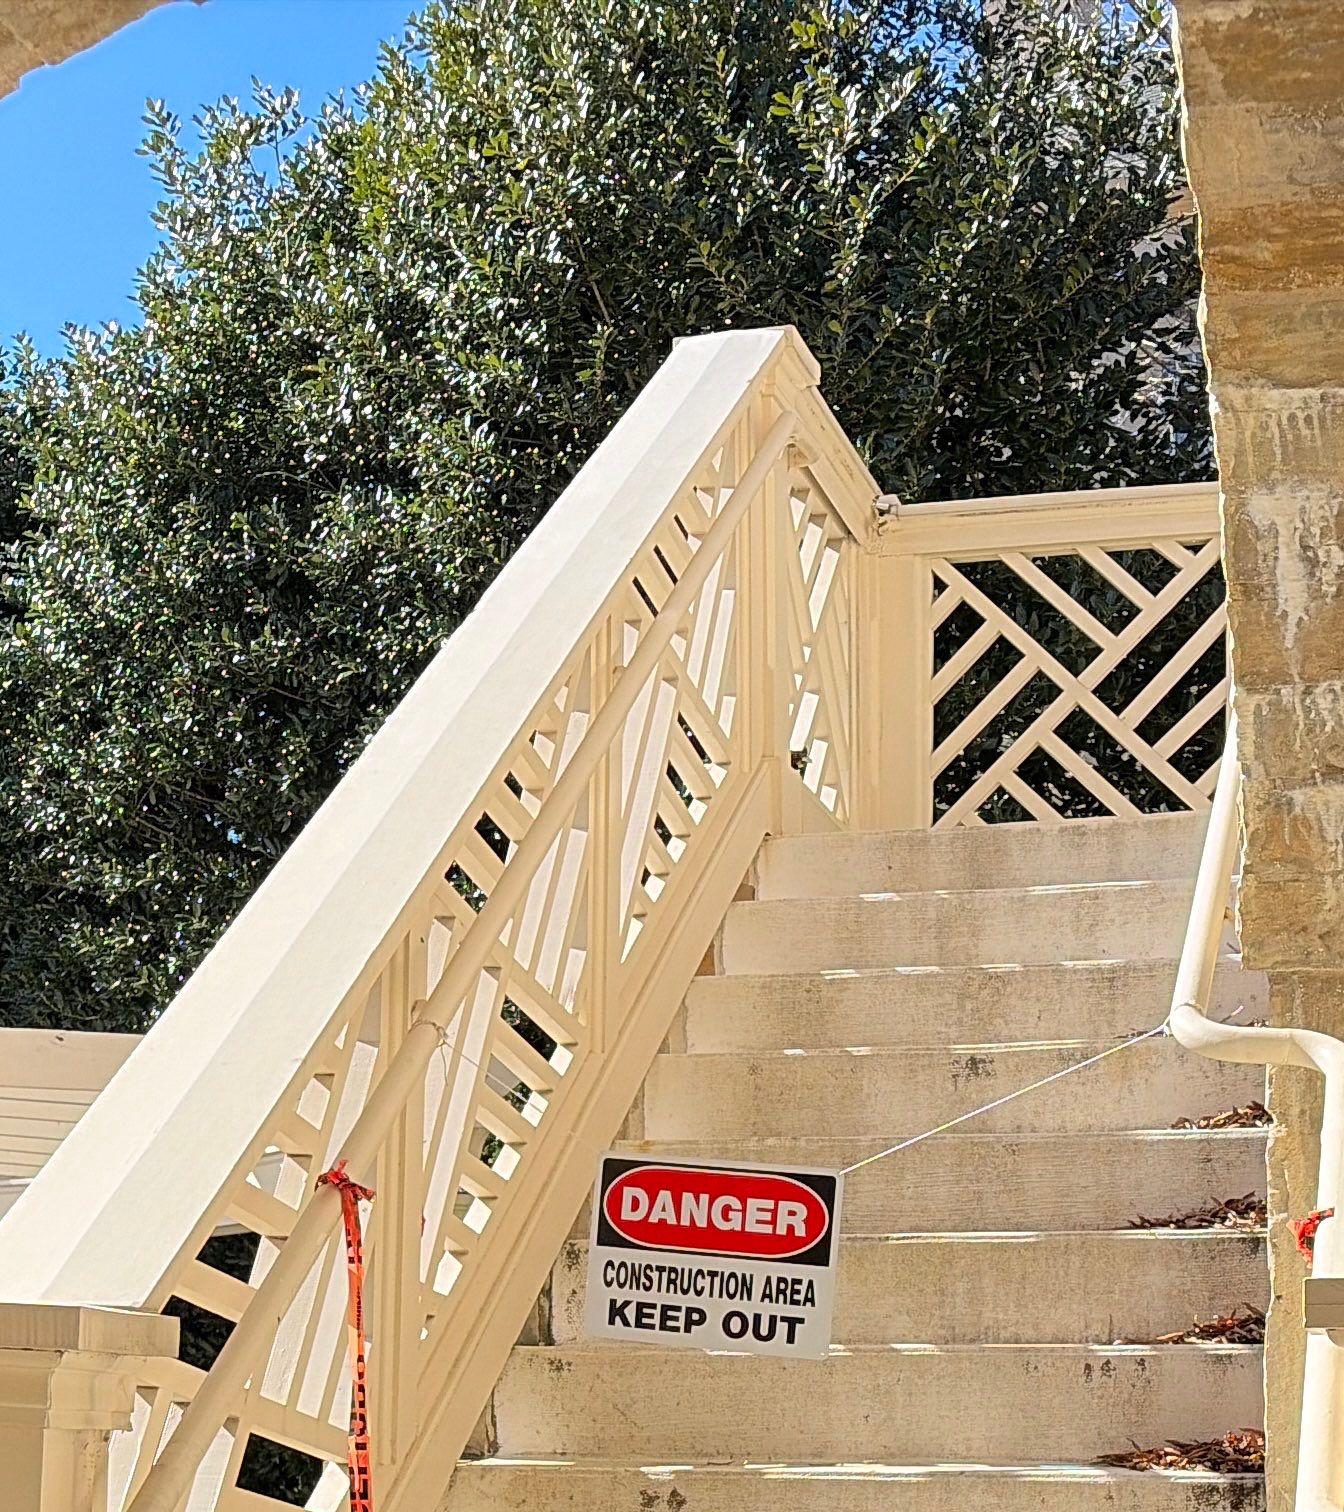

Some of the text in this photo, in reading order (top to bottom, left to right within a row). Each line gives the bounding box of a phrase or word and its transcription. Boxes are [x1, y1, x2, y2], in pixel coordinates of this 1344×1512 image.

[620, 1185, 808, 1237] DANGER
[603, 1259, 816, 1307] CONSTRUCTION AREA
[607, 1298, 805, 1345] KEEP OUT
